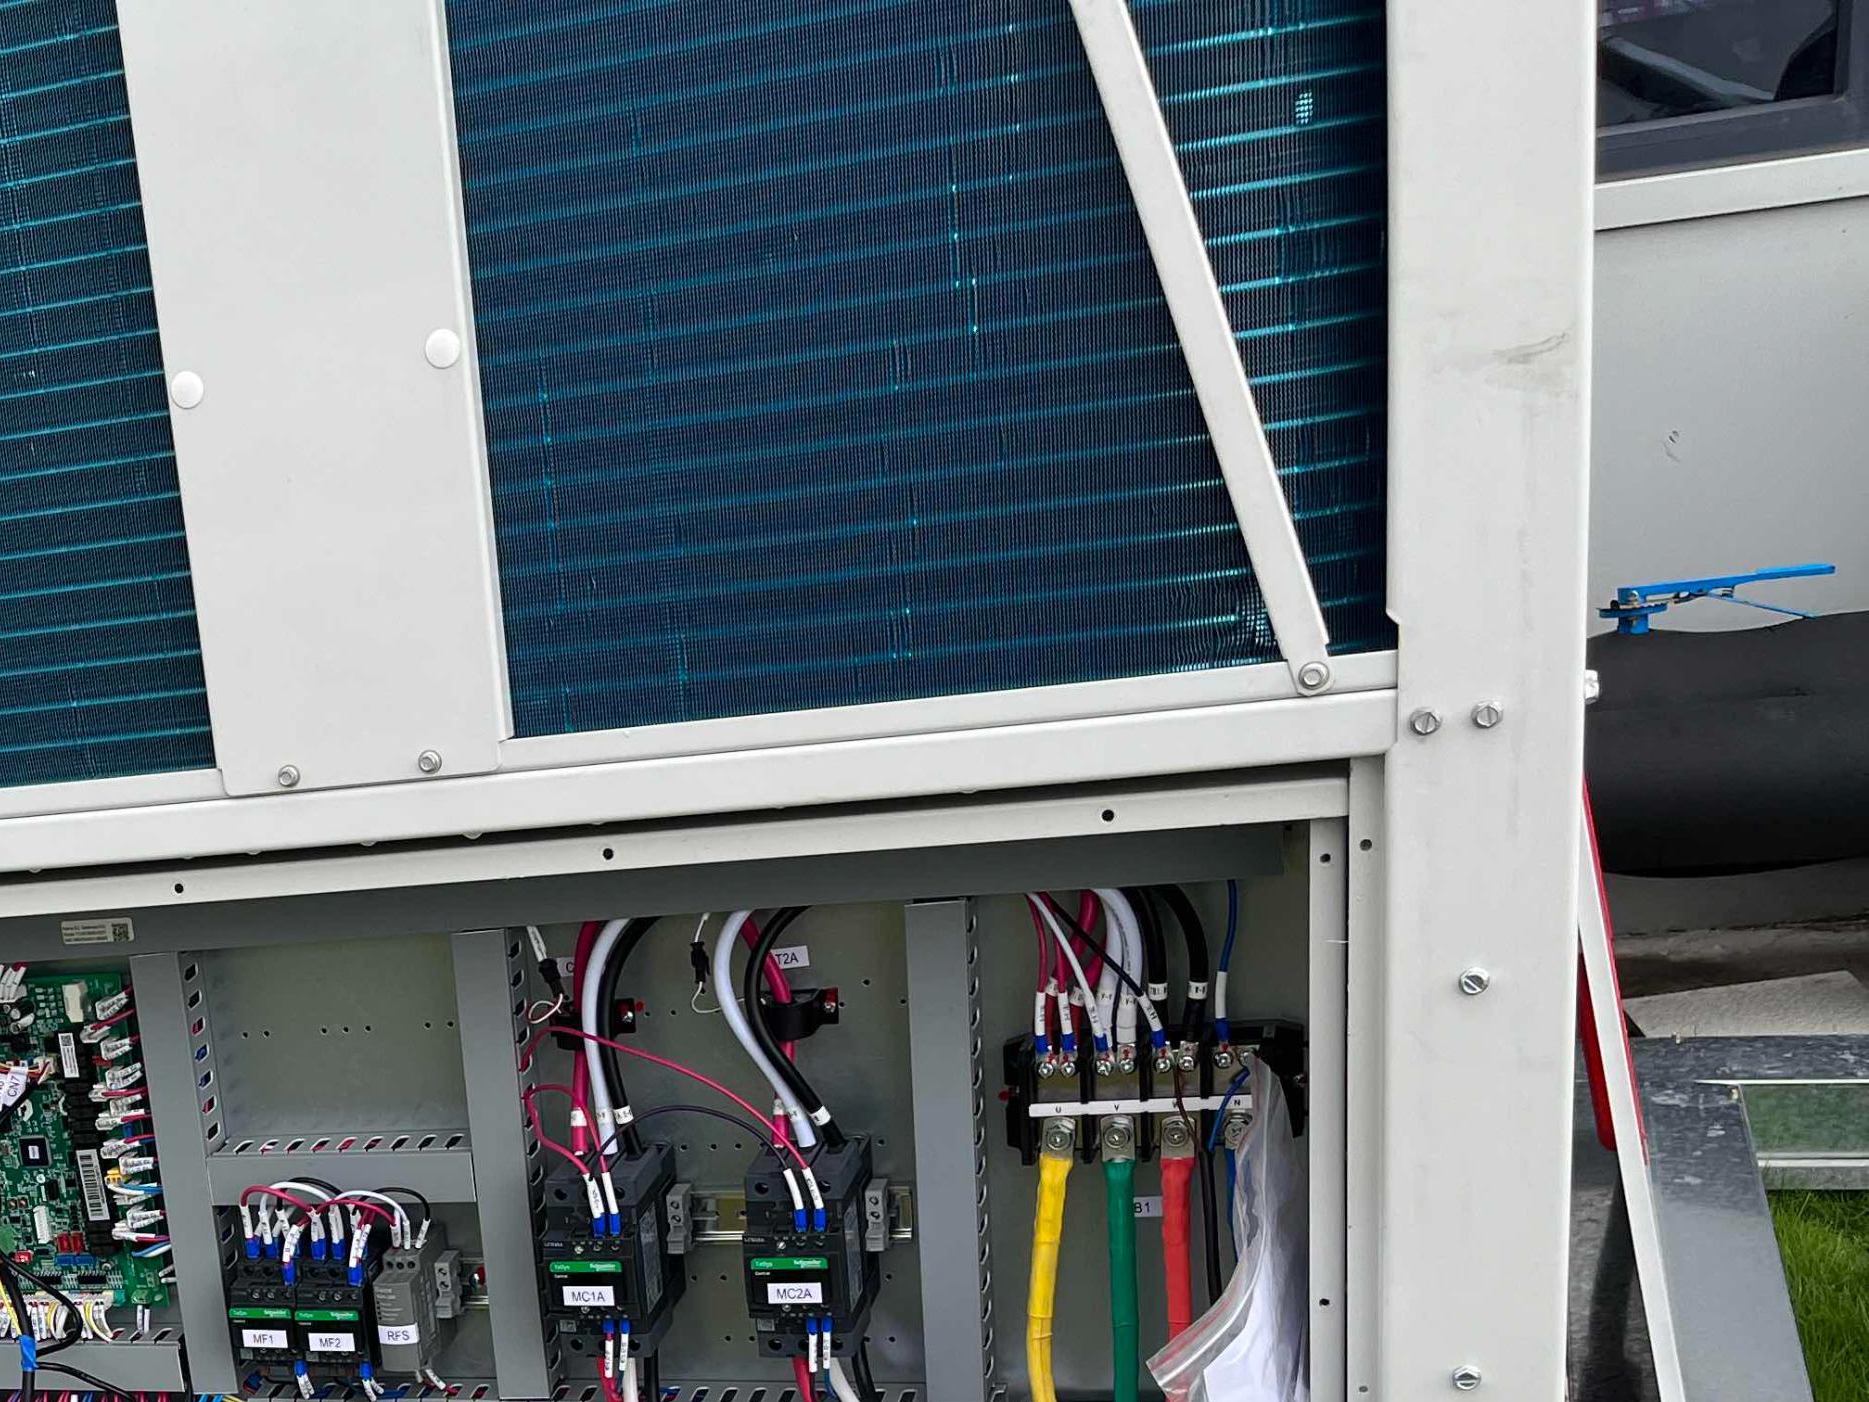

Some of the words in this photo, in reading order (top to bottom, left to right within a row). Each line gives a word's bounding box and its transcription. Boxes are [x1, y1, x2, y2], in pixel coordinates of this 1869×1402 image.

[7, 1074, 21, 1098] CN7
[571, 1291, 606, 1302] MC1A
[776, 1288, 813, 1300] MC2A
[253, 1333, 274, 1344] MF1
[387, 1330, 410, 1341] RFS
[319, 1337, 341, 1348] MF2
